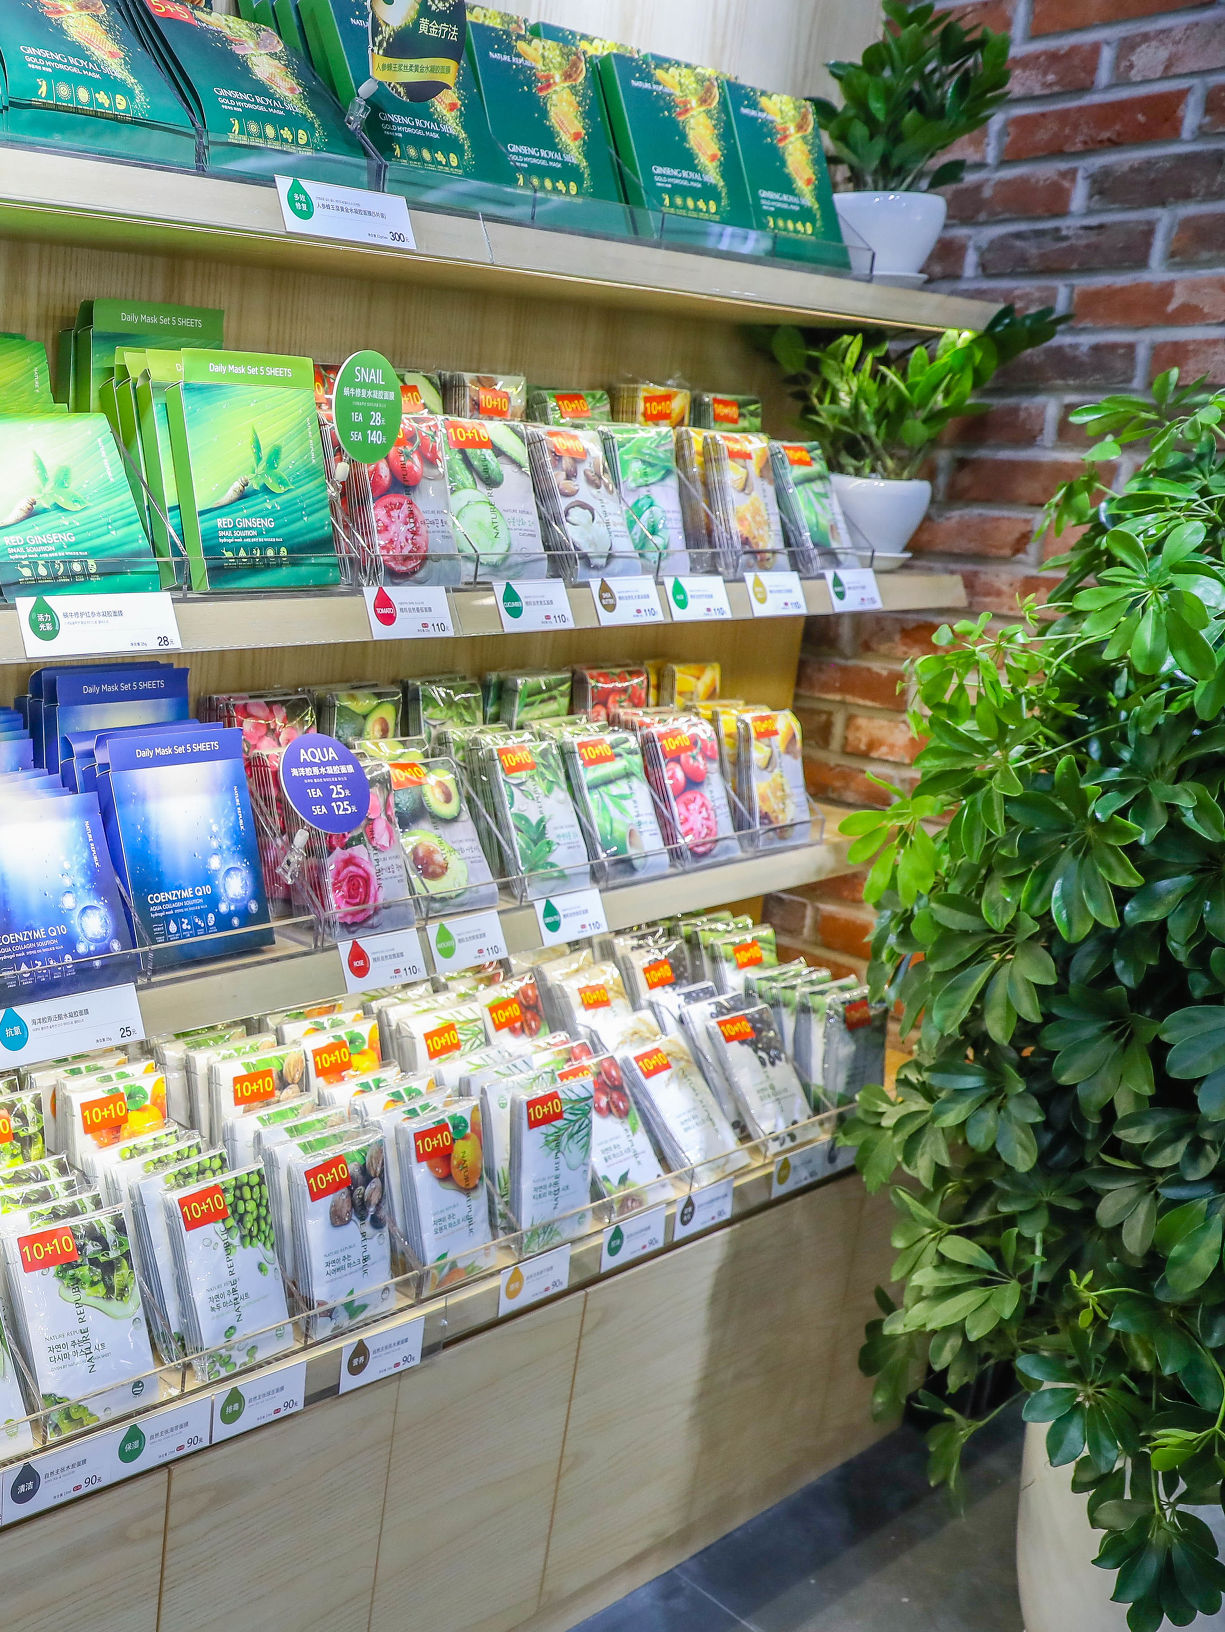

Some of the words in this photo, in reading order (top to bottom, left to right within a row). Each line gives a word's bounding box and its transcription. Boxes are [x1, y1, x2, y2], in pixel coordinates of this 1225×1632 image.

[418, 18, 459, 42] 黄金疗法
[120, 312, 139, 324] Daily
[140, 314, 158, 325] Mask
[159, 315, 171, 326] Set
[171, 316, 177, 326] 5
[177, 317, 203, 328] SHEETS
[209, 362, 227, 375] Daily
[228, 364, 245, 375] Mask
[246, 365, 258, 375] Set
[259, 365, 265, 375] 5
[265, 366, 292, 378] SHEETS
[354, 366, 385, 385] SNAIL
[480, 394, 509, 411] 10+10
[558, 399, 588, 414] 10+10
[645, 400, 672, 416] 10+10
[351, 412, 363, 423] 1EA
[448, 426, 490, 443] 10+10
[217, 518, 235, 529] RED
[236, 518, 275, 529] GINSENG
[4, 535, 25, 546] RED
[26, 532, 75, 546] GINSENG
[376, 607, 394, 615] TOMATO
[82, 685, 100, 695] Daily
[101, 683, 119, 693] Mask
[120, 682, 132, 691] Set
[132, 681, 138, 690] 5
[138, 680, 165, 690] SHEETS
[136, 749, 154, 759] Daily
[155, 747, 173, 756] Mask
[174, 745, 186, 754] Set
[186, 744, 192, 753] 5
[192, 741, 219, 752] SHEETS
[580, 742, 613, 760] 10+10
[662, 734, 691, 751] 10+10
[300, 747, 339, 764] AQUA
[500, 750, 533, 768] 10+10
[391, 765, 424, 782] 10+10
[306, 788, 323, 798] 1EA
[147, 888, 194, 904] COENZYME
[194, 884, 212, 896] Q10
[47, 924, 68, 937] Q10
[353, 959, 364, 967] ROSE
[646, 967, 672, 984] 10+10
[581, 988, 608, 1005] 10+10
[491, 1002, 521, 1024] 10+10
[721, 1020, 751, 1036] 10+10
[426, 1030, 458, 1053] 10+10
[314, 1048, 350, 1069] 10+10
[638, 1052, 669, 1073] 10+10
[234, 1076, 274, 1098] 10+10
[83, 1101, 126, 1126] 10+10
[528, 1098, 563, 1123] 10+10
[416, 1131, 452, 1154] 10+10
[308, 1163, 349, 1193] 10+10
[182, 1193, 225, 1222] 10+10
[22, 1235, 74, 1263] 10+10
[47, 1342, 69, 1354] 자연이
